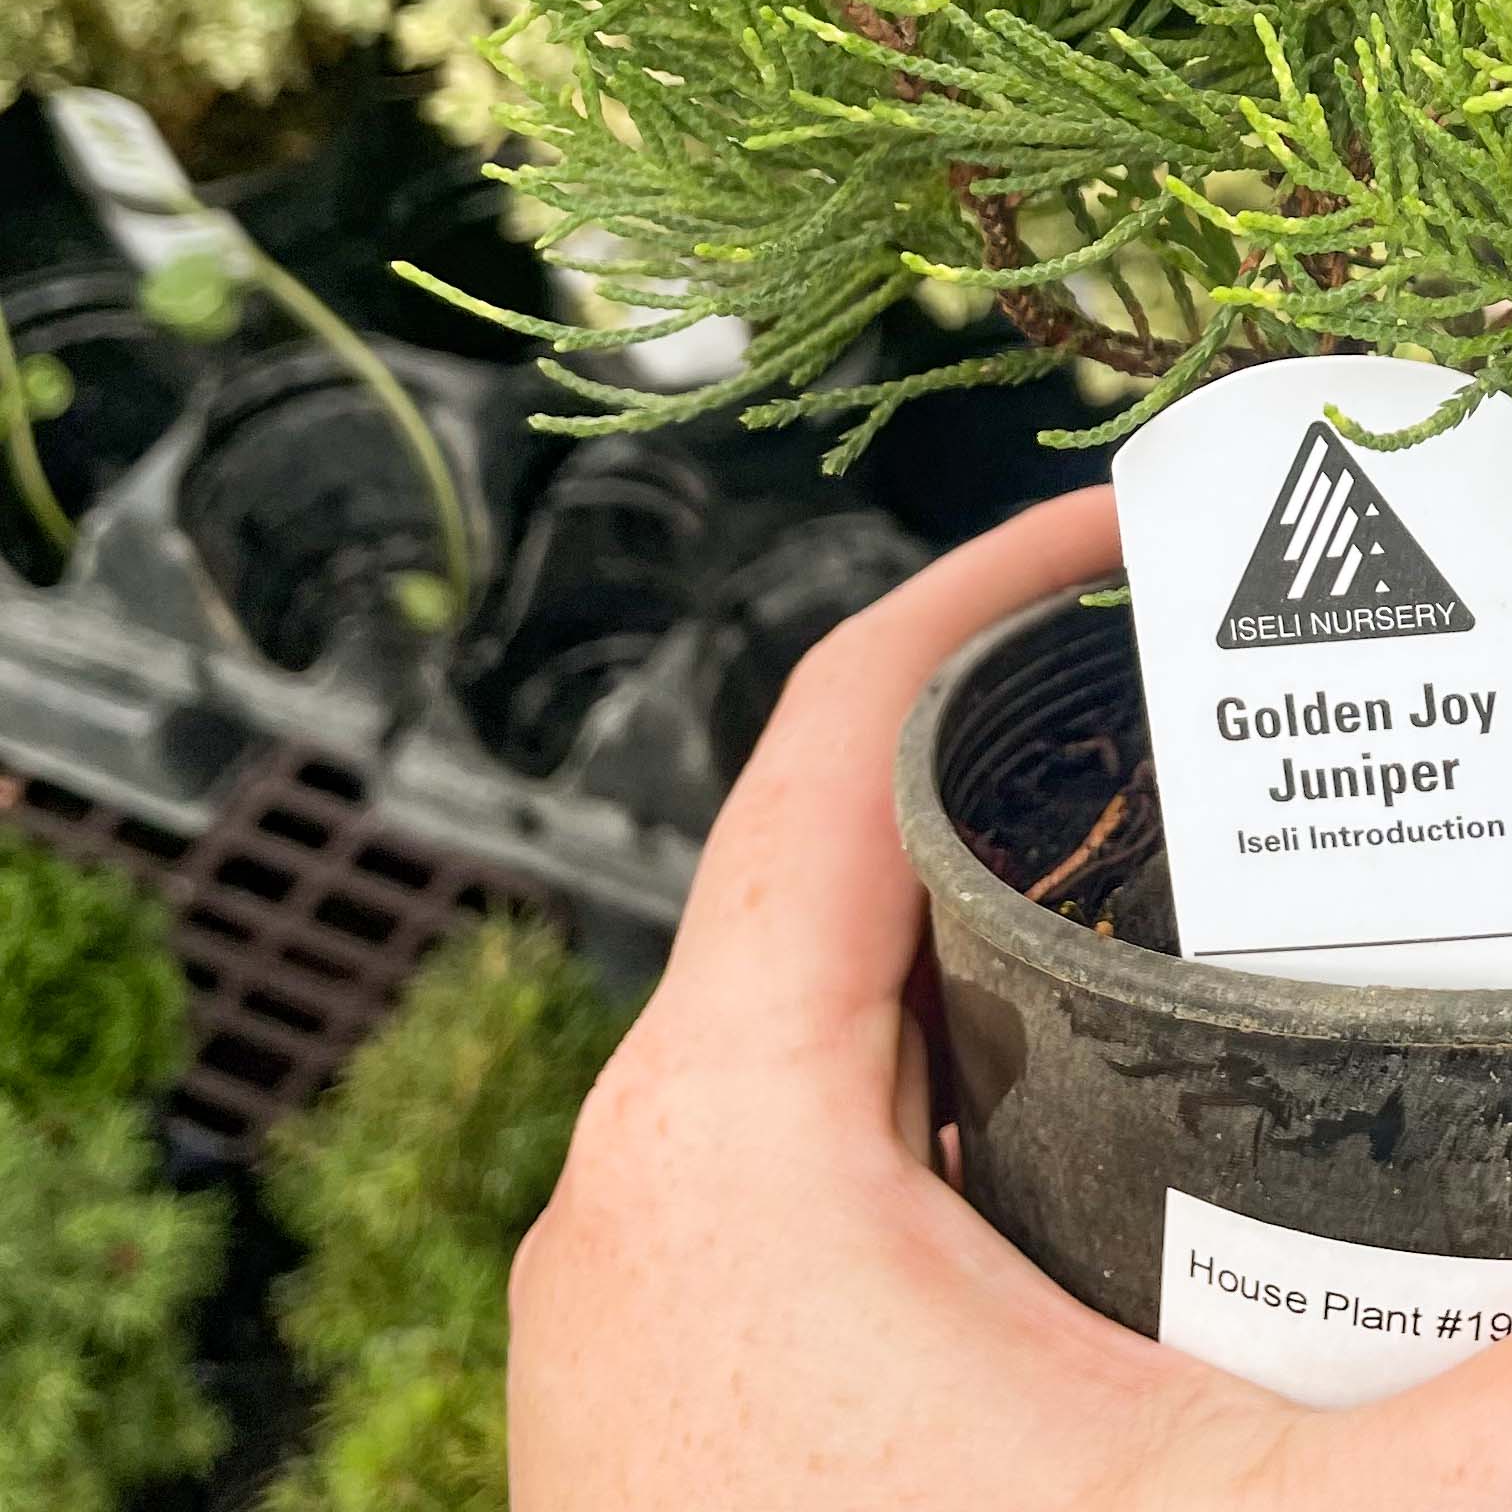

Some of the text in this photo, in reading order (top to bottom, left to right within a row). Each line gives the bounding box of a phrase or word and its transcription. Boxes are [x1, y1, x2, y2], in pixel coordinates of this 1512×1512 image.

[1229, 601, 1456, 641] ISELI NURSERY
[1216, 682, 1497, 741] Golden Joy
[1268, 752, 1460, 807] Juniper
[1237, 815, 1506, 854] Iseli Introduction
[1189, 1248, 1308, 1315] House
[1322, 1290, 1423, 1337] Plant
